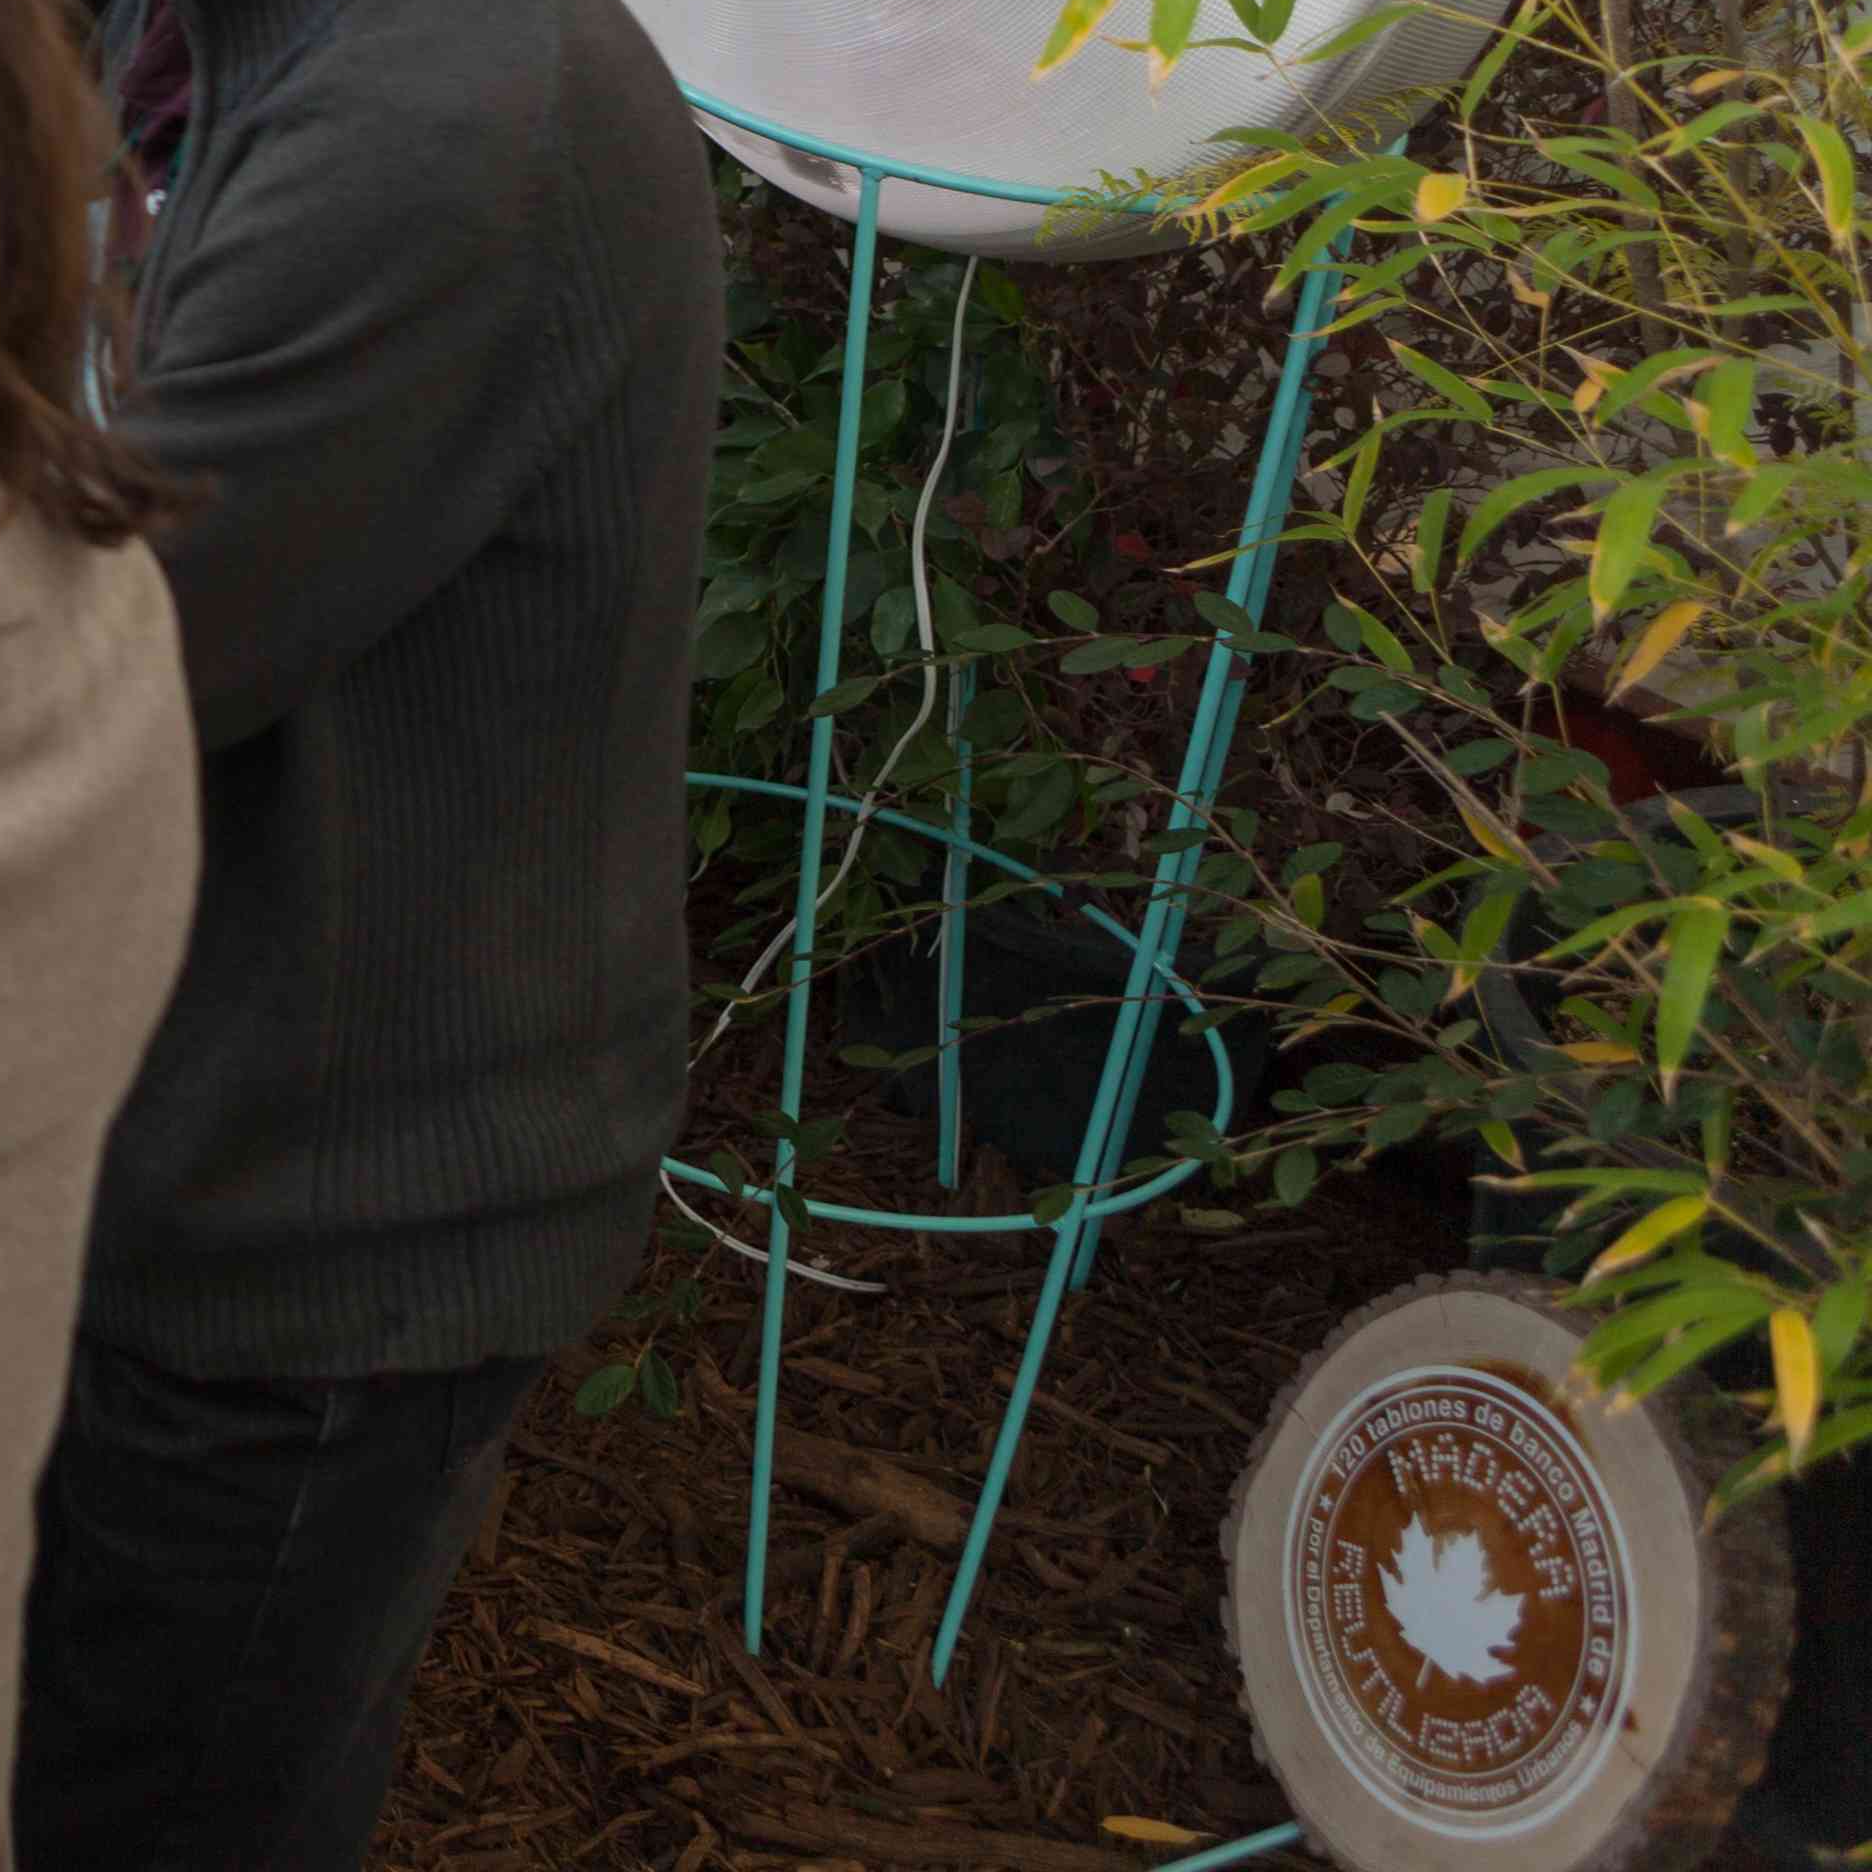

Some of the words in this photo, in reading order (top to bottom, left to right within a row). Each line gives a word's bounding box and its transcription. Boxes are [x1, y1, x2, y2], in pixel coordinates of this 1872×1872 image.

[1364, 1396, 1468, 1450] tablones
[1474, 1398, 1506, 1433] de
[1329, 1433, 1363, 1480] 120
[1509, 1417, 1577, 1502] banco
[1386, 1431, 1576, 1601] MADERA
[1570, 1504, 1613, 1627] Madrid
[1584, 1630, 1611, 1675] de
[1306, 1584, 1362, 1734] Departamento
[1387, 1757, 1519, 1803] Equipamientos
